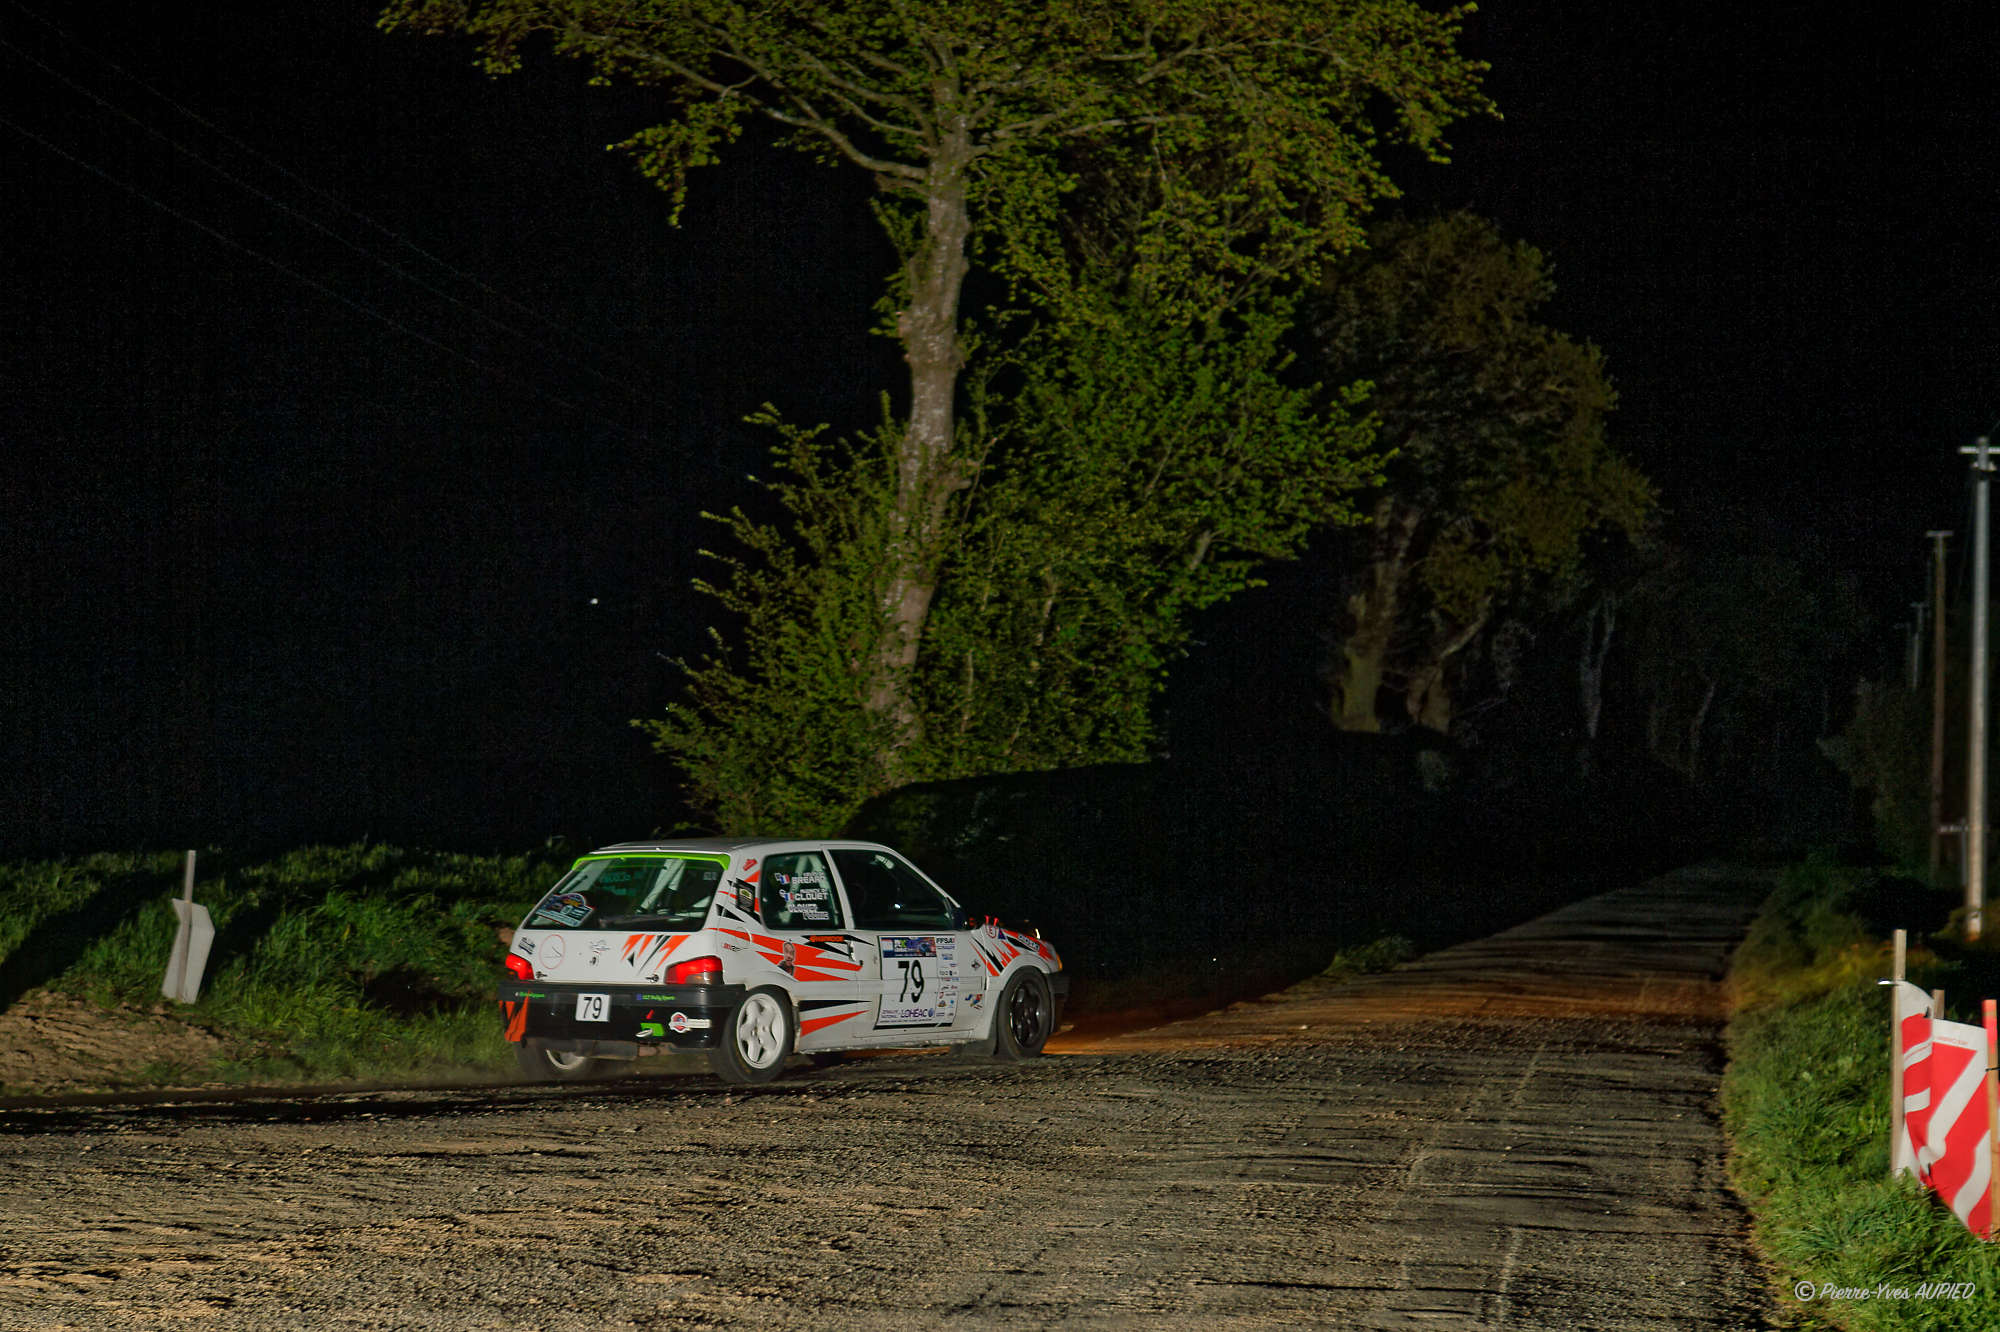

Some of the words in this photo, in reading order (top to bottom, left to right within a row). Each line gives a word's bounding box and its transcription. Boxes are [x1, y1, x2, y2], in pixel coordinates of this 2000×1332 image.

[794, 892, 829, 901] CLOUET
[897, 960, 925, 1003] 79
[583, 996, 603, 1020] 79
